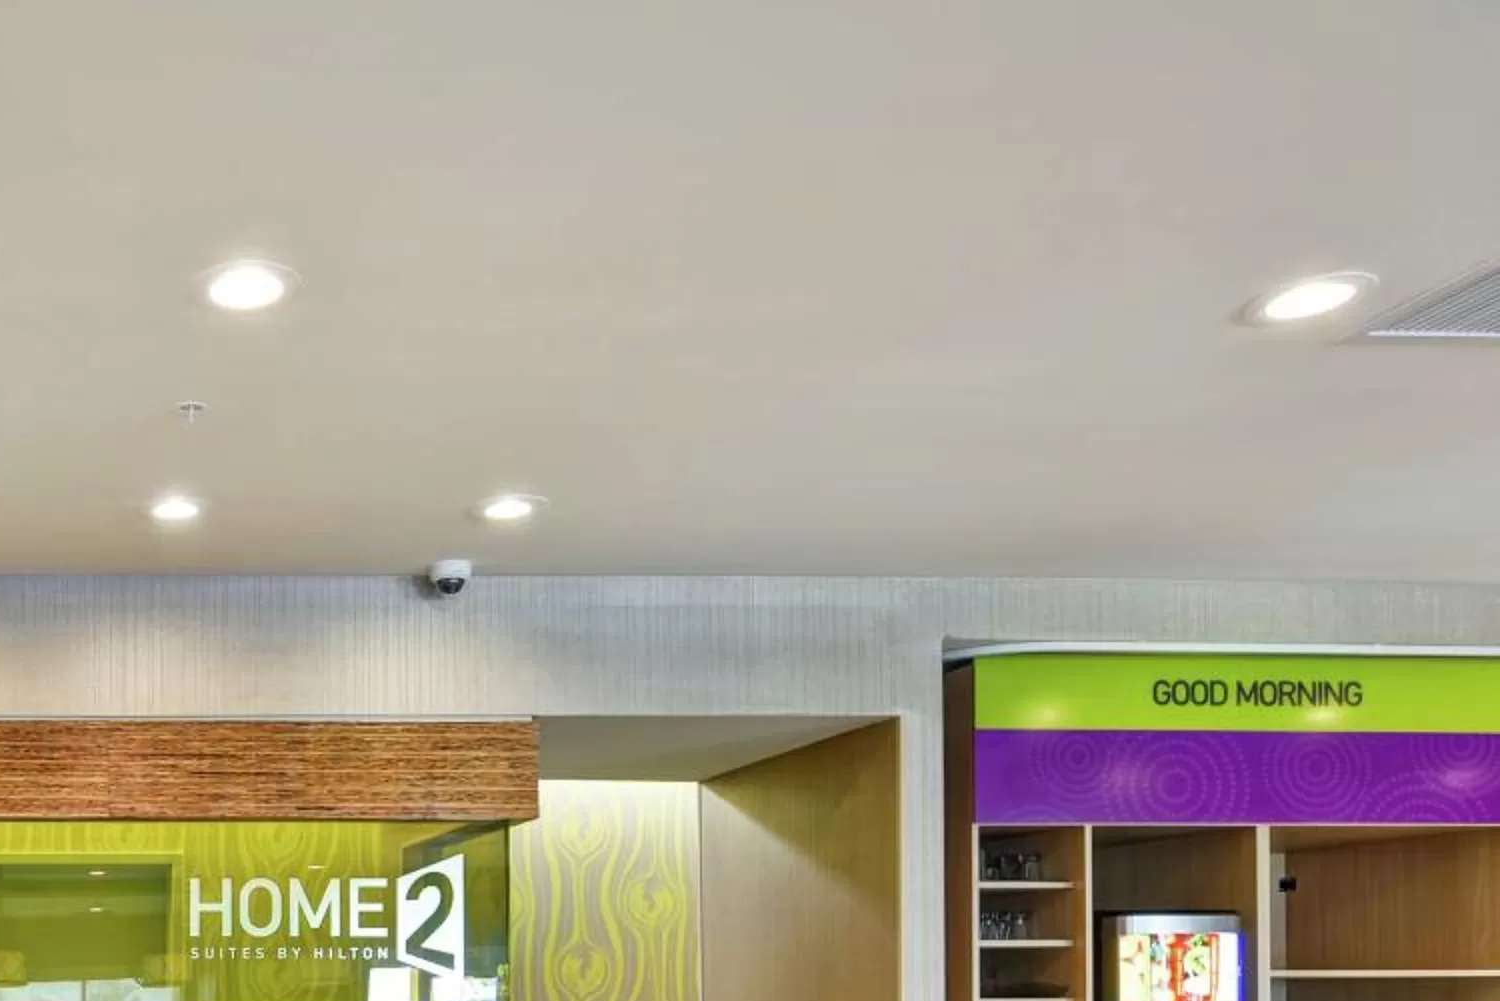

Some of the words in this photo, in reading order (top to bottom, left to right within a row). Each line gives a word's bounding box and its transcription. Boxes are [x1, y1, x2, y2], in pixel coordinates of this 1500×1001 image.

[1152, 679, 1229, 706] GOOD
[1235, 680, 1364, 707] MORNING
[189, 877, 389, 938] HOME
[190, 947, 265, 960] SUITES
[277, 946, 301, 960] BY
[312, 946, 389, 960] HILTON
